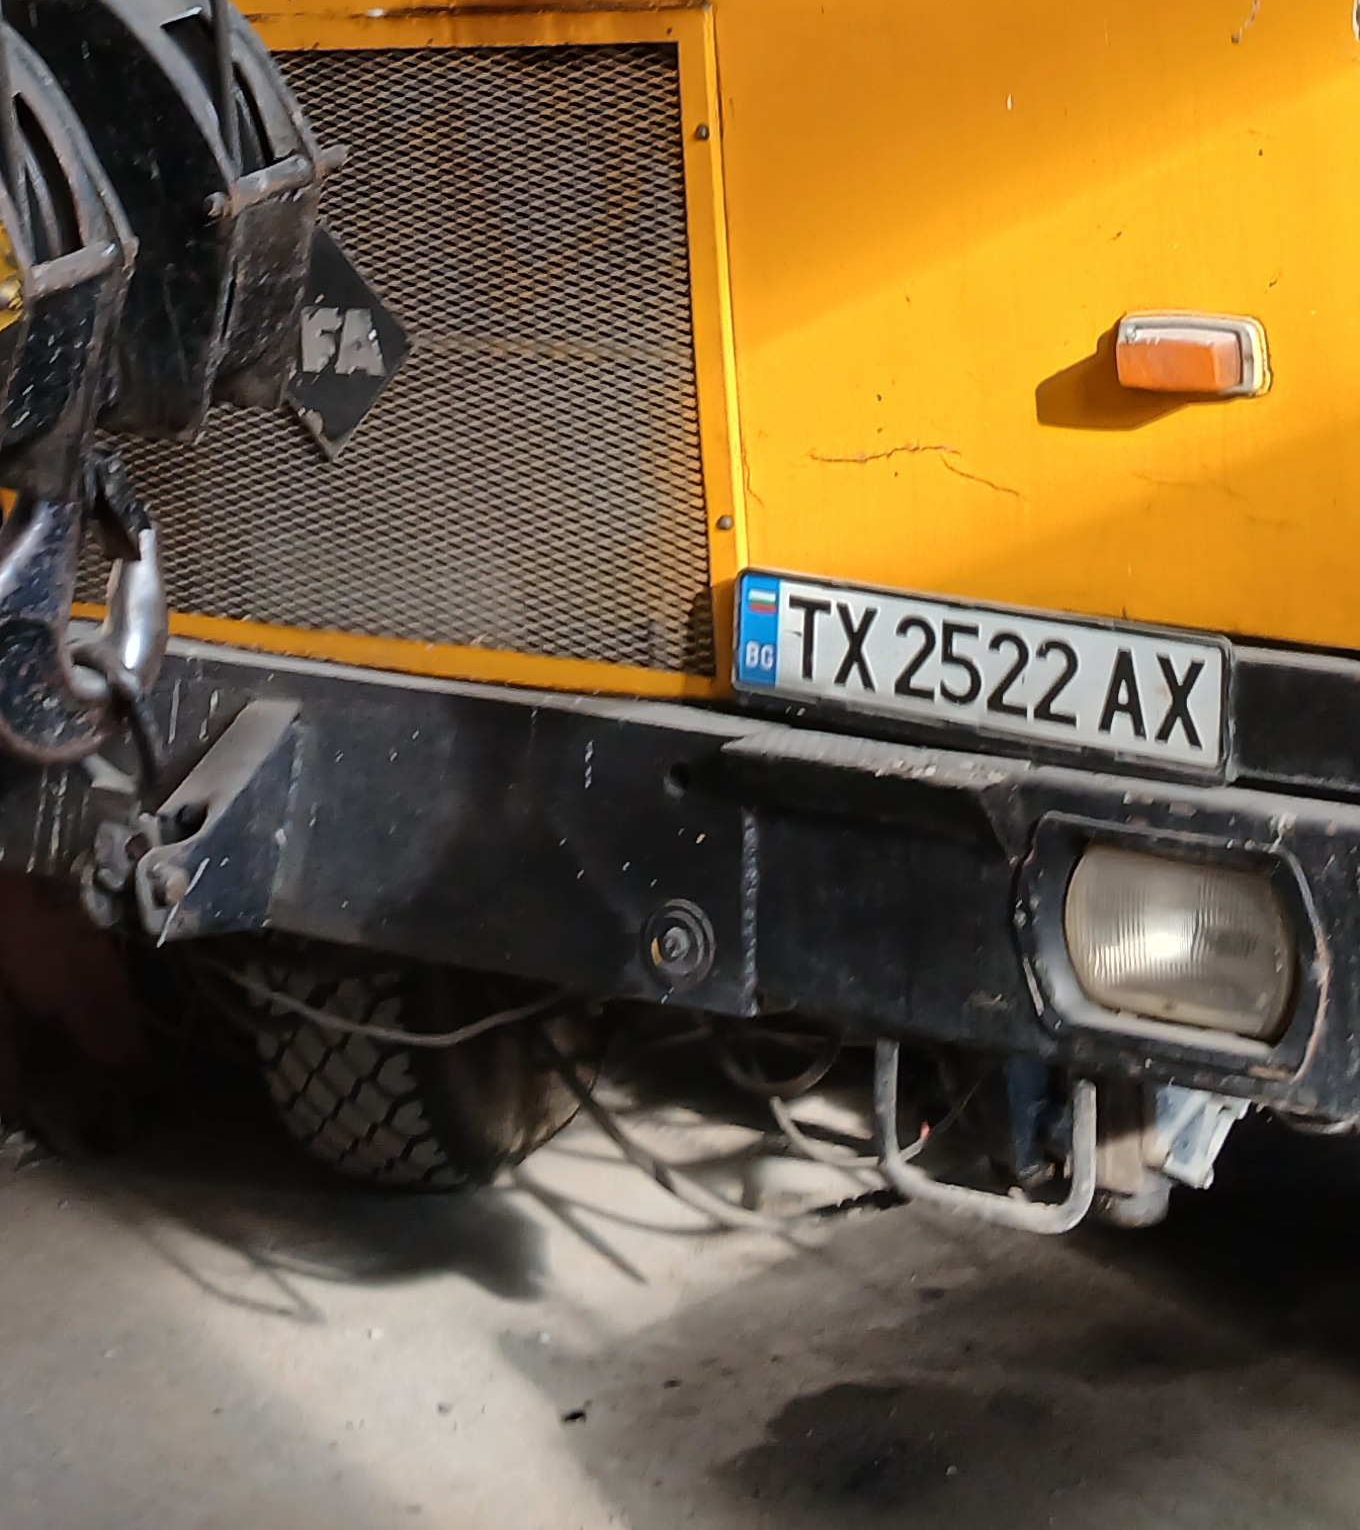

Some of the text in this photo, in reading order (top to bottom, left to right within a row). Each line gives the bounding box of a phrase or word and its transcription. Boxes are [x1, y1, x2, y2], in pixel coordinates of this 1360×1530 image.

[300, 305, 387, 377] FA
[745, 640, 775, 671] BG
[788, 594, 1206, 752] TX 2522 AX
